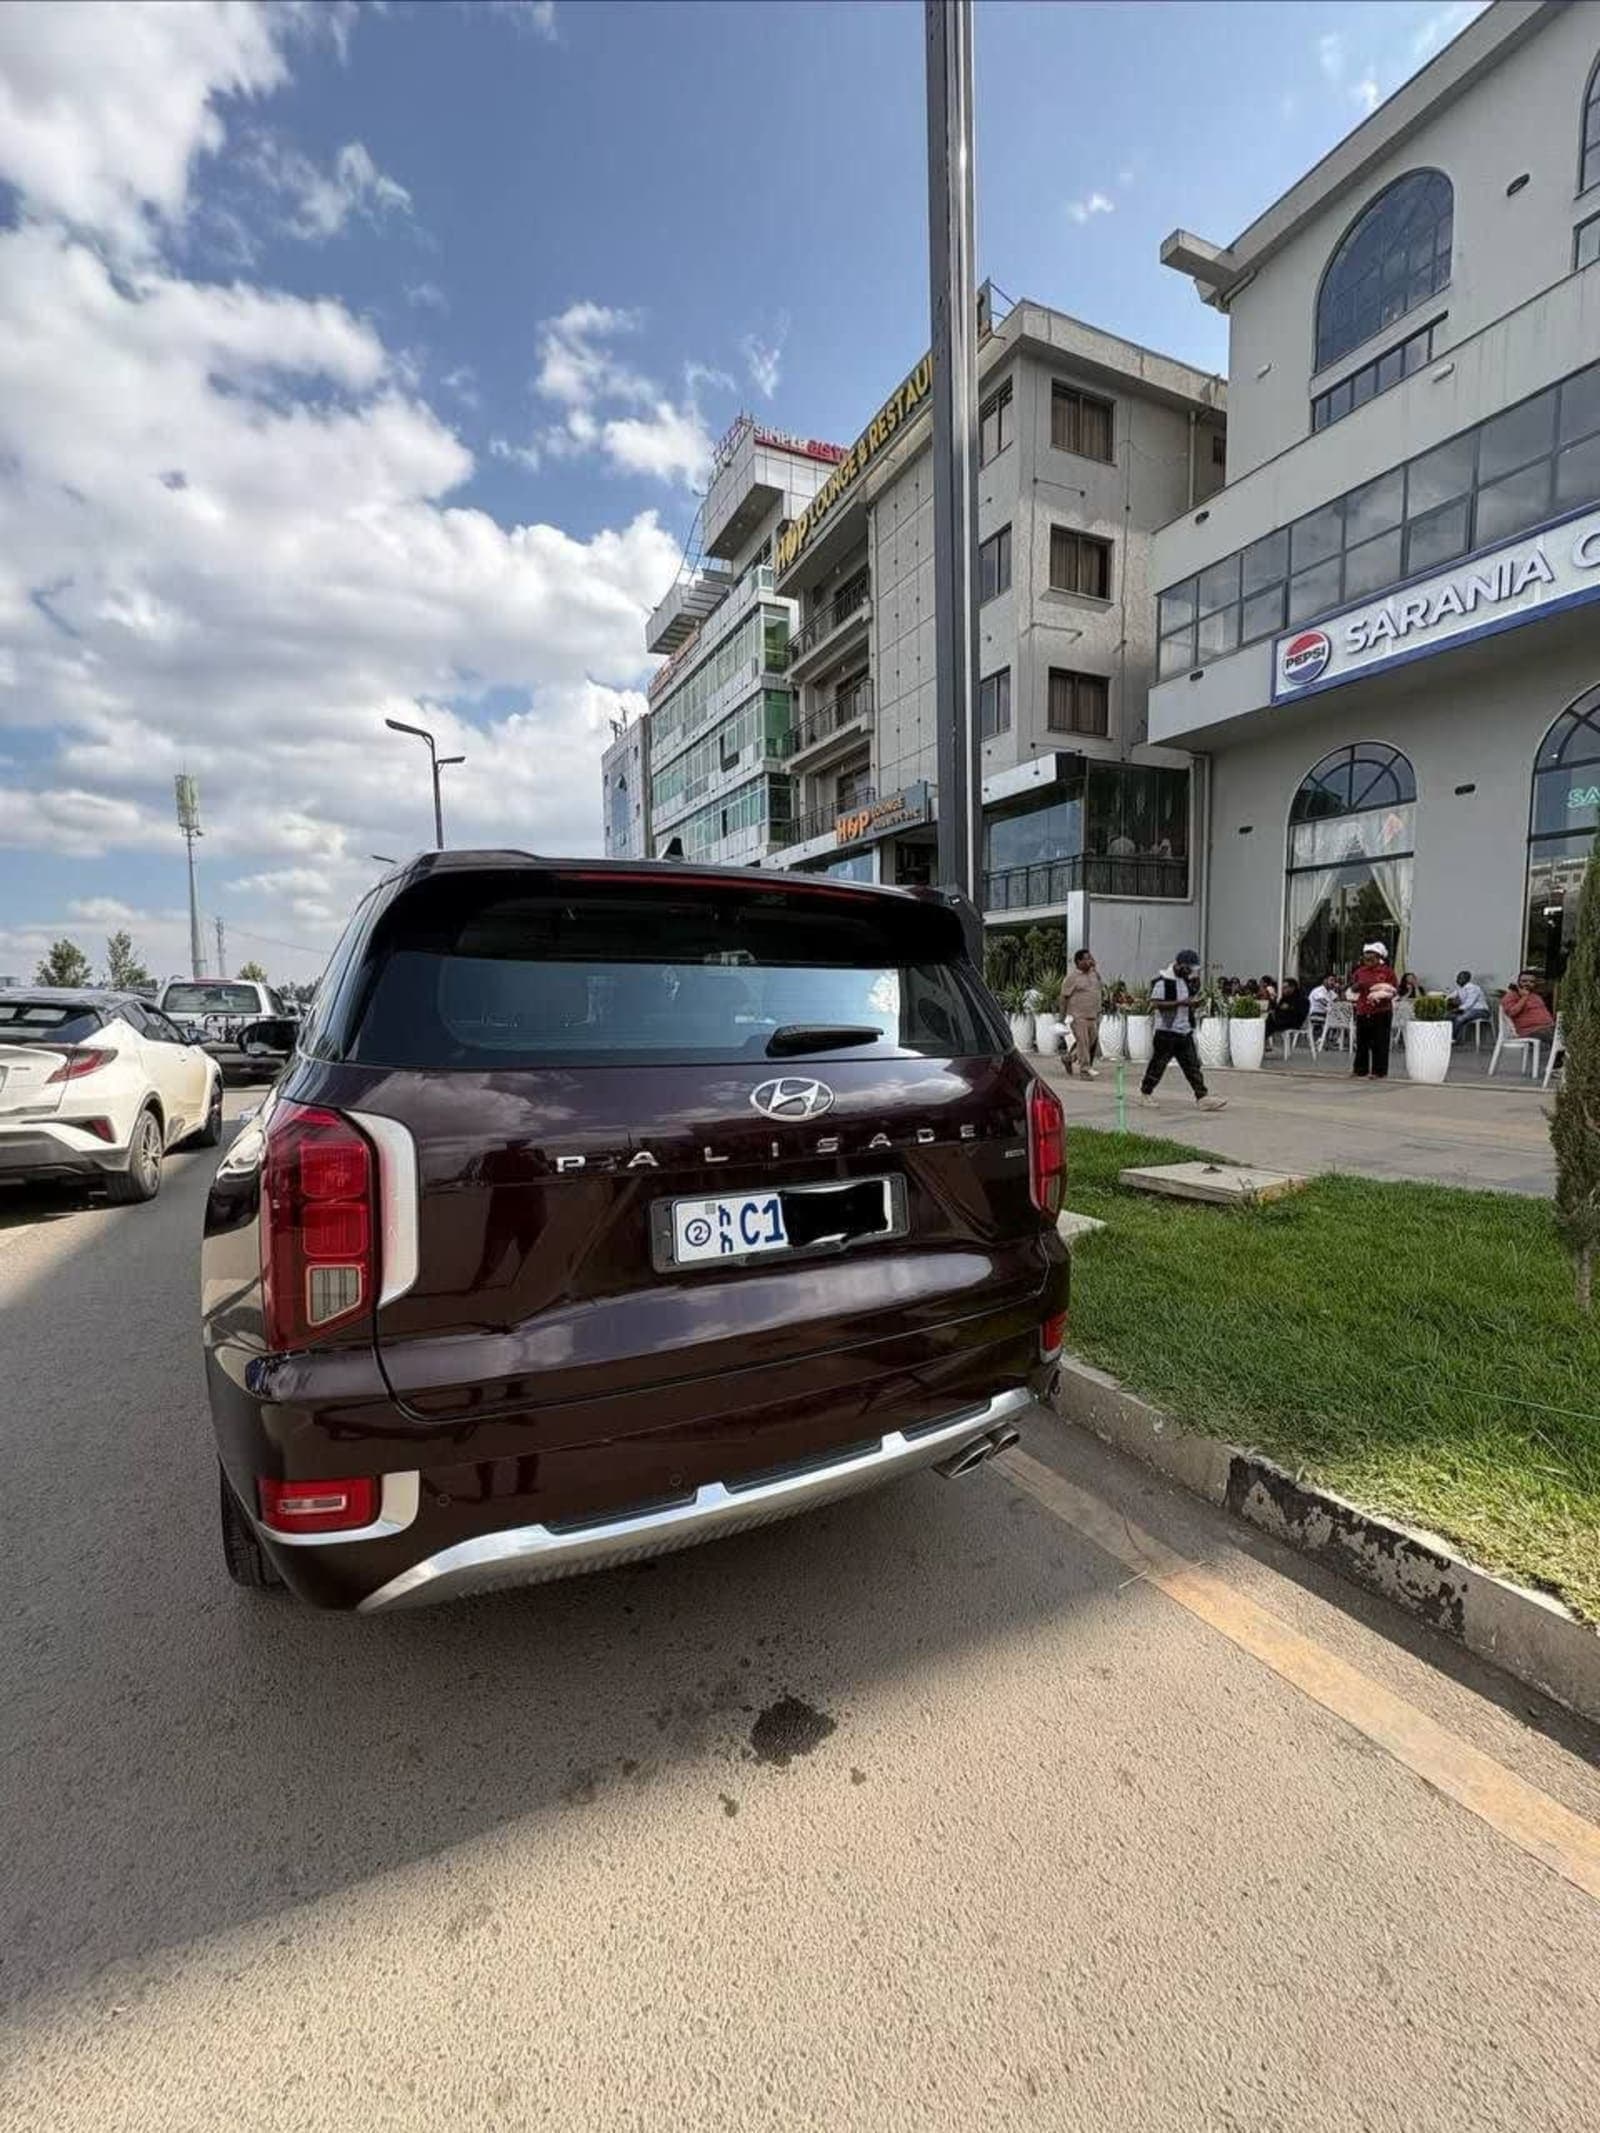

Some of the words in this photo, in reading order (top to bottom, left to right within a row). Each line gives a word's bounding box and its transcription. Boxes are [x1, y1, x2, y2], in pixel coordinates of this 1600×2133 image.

[774, 519, 809, 573] HOP
[809, 452, 860, 526] LOUNGE
[857, 440, 870, 466] &
[868, 353, 934, 452] RESTAU
[1344, 550, 1554, 655] SARANIA
[1286, 647, 1326, 670] PEPSI
[836, 810, 872, 843] HOP
[555, 1123, 976, 1174] PALISADE
